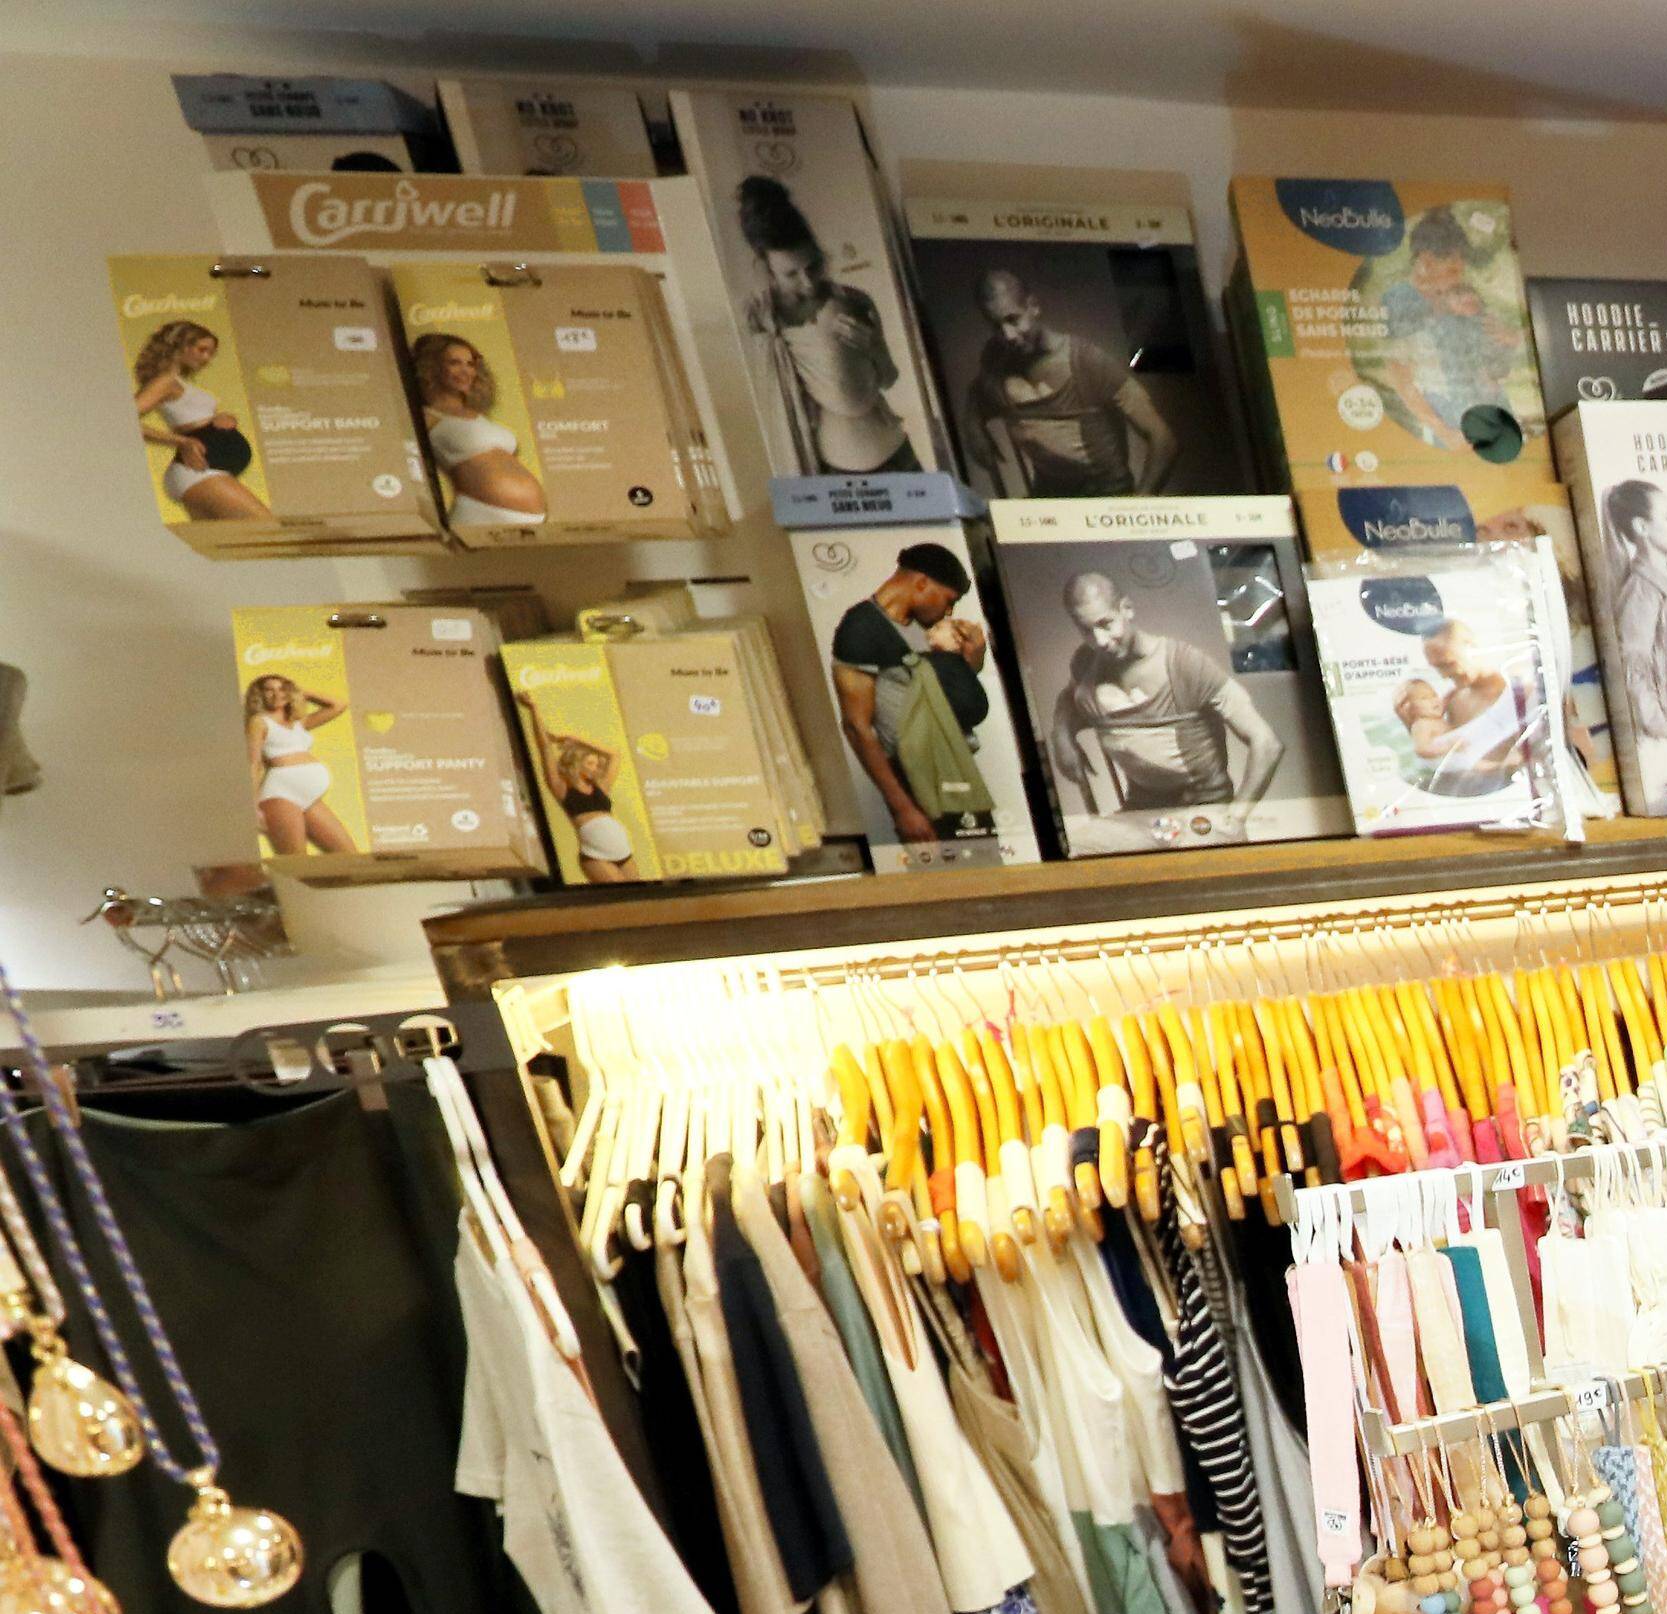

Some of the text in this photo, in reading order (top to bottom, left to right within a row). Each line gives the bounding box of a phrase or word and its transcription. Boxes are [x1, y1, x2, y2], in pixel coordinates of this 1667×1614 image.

[290, 181, 517, 246] Carriwell
[993, 214, 1110, 231] L'ORIGINALE
[1296, 324, 1338, 338] SANS
[260, 415, 380, 433] SUPPORT BAND
[537, 419, 609, 433] COMFORT
[1085, 511, 1209, 530] L'ORIGINALE
[364, 756, 485, 773] SUPPORT PANTY
[665, 850, 781, 875] DELUXE
